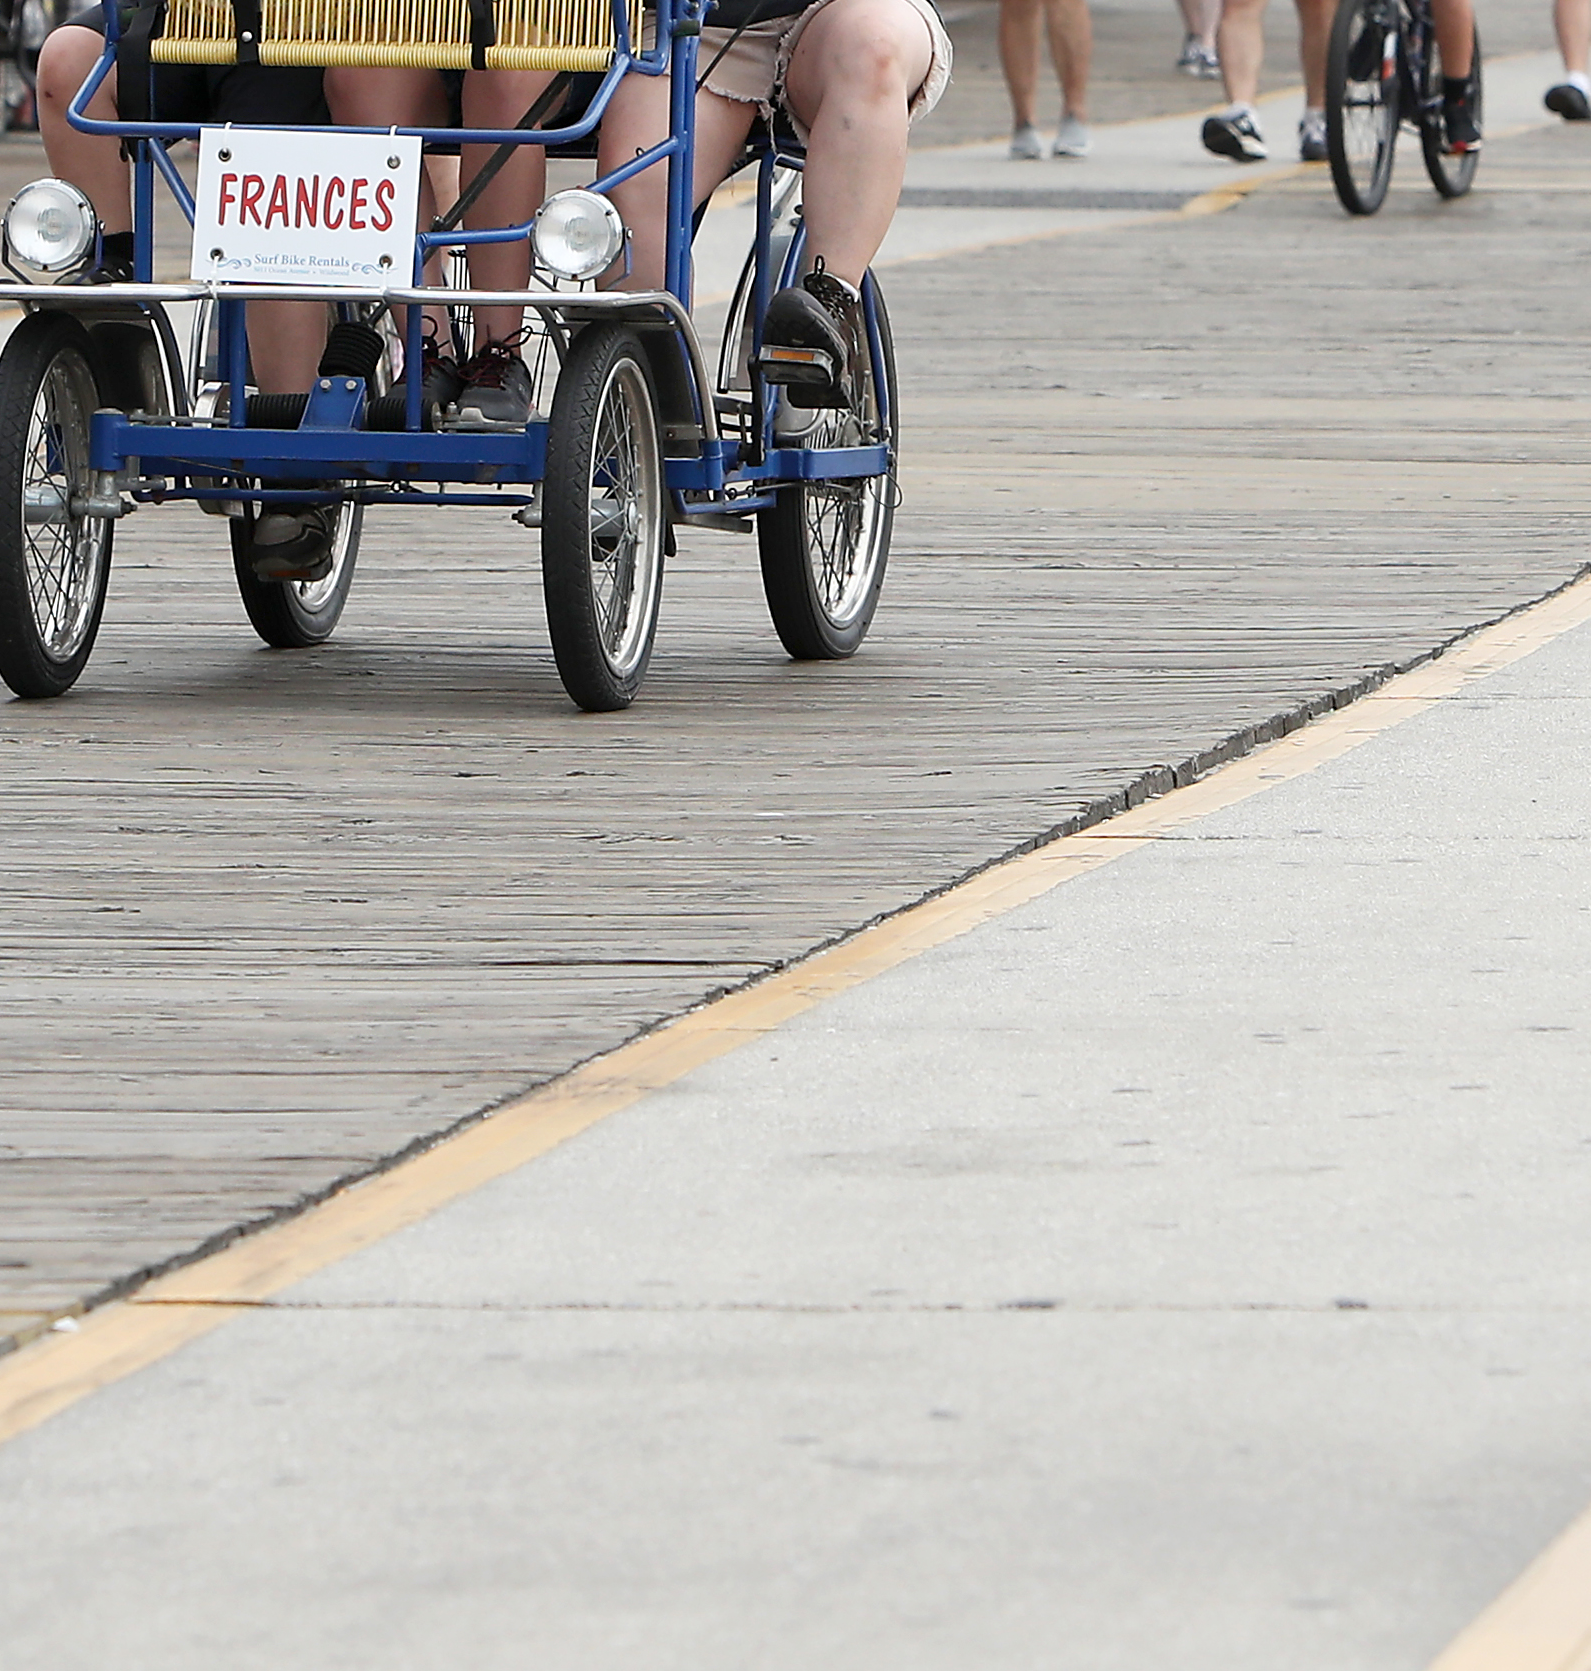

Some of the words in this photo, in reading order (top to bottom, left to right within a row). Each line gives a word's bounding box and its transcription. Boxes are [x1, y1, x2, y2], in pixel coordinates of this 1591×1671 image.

[218, 173, 395, 232] FRANCES
[254, 253, 280, 265] Surf
[281, 254, 306, 266] Bike
[308, 255, 350, 268] Rentals
